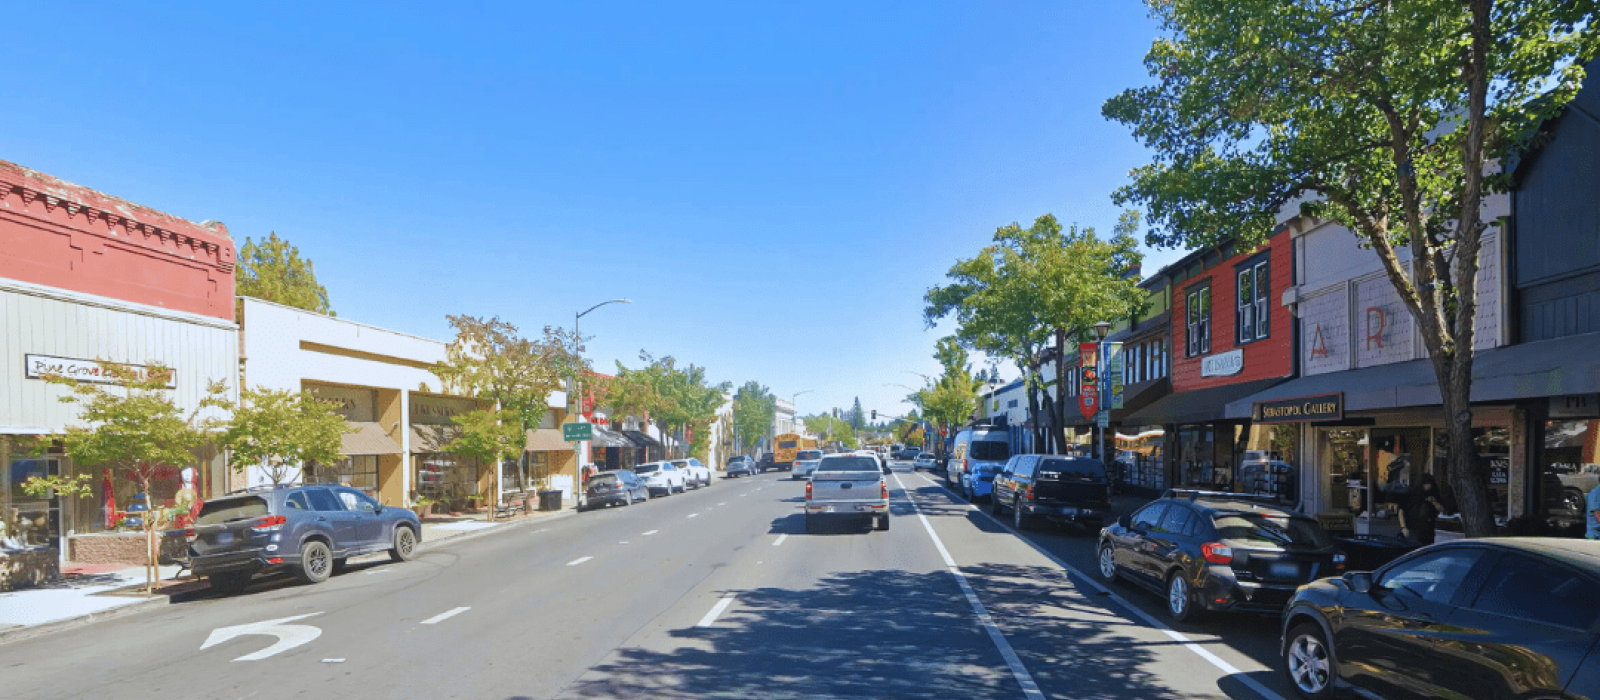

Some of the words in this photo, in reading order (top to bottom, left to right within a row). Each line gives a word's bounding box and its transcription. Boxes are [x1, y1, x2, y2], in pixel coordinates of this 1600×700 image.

[1309, 322, 1328, 361] A
[1366, 307, 1385, 351] R
[34, 359, 63, 374] Pine
